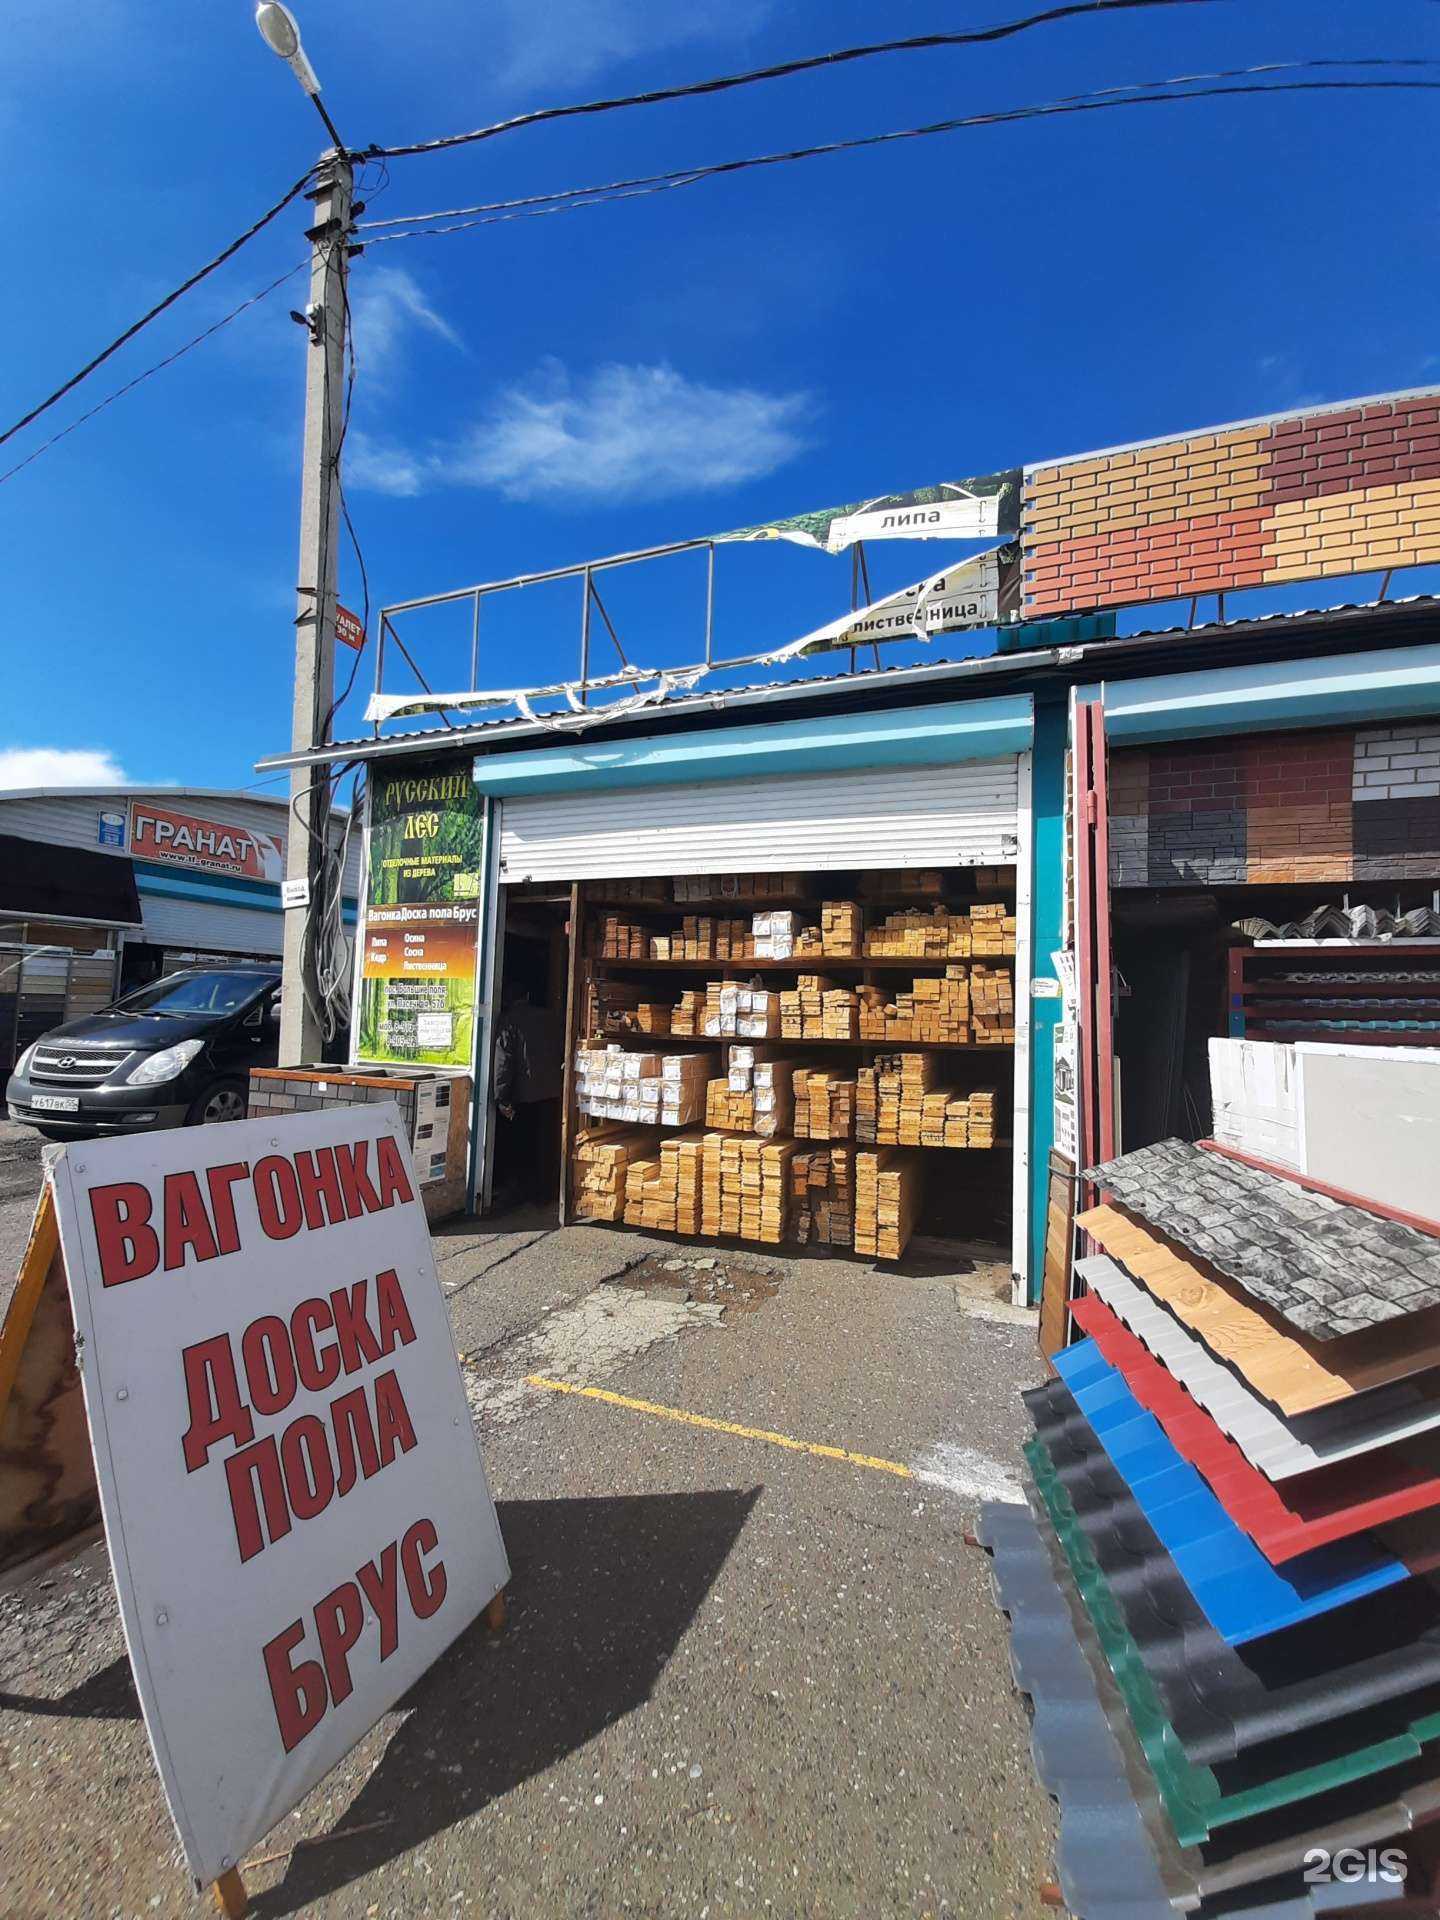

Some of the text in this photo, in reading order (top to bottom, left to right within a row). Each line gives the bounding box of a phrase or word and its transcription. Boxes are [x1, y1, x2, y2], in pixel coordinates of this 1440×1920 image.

[881, 510, 941, 529] липа
[385, 769, 469, 813] РУССКИЙ
[135, 815, 253, 862] ГРАНАТ
[403, 813, 440, 840] ЛЕС
[412, 867, 436, 878] ДЕРЕВА
[420, 854, 463, 865] МАТЕРИАЛЫ
[368, 905, 477, 922] Вагонка Доска пола Брус
[88, 1135, 414, 1288] ВАГОНКА
[181, 1268, 417, 1474] ДОСКА
[223, 1369, 417, 1564] ПОЛА
[262, 1518, 447, 1754] БРУС
